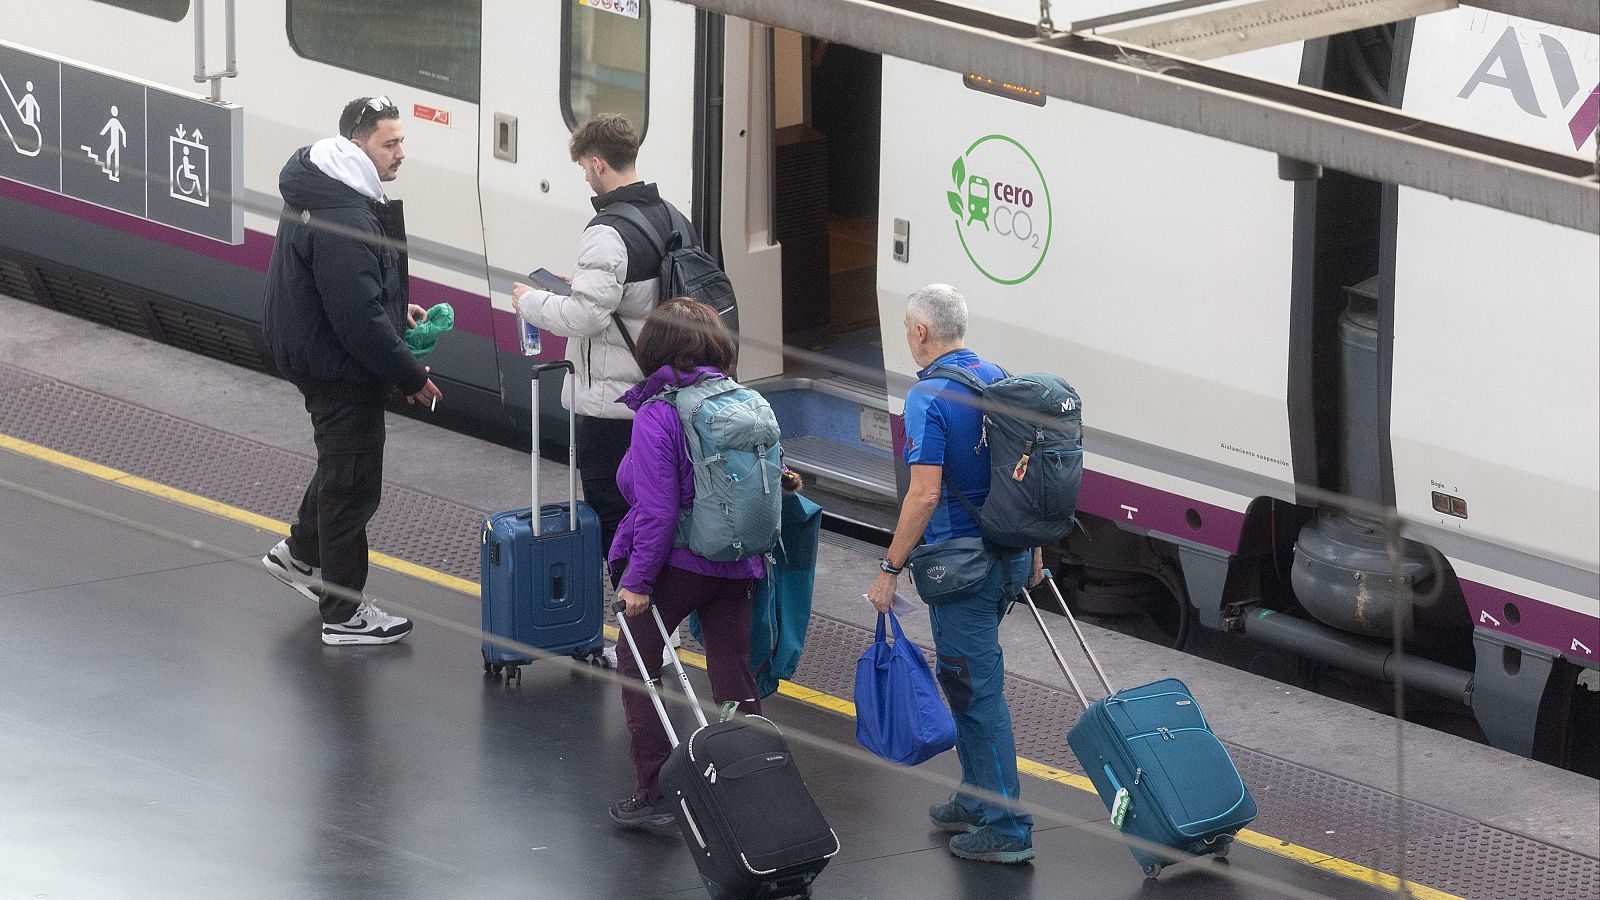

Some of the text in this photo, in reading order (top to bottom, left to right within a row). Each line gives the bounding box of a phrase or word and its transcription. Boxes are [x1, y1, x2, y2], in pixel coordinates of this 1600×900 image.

[994, 182, 1033, 208] cero
[1220, 442, 1290, 467] Aislamiento suspensión
[926, 565, 946, 575] OSPREY
